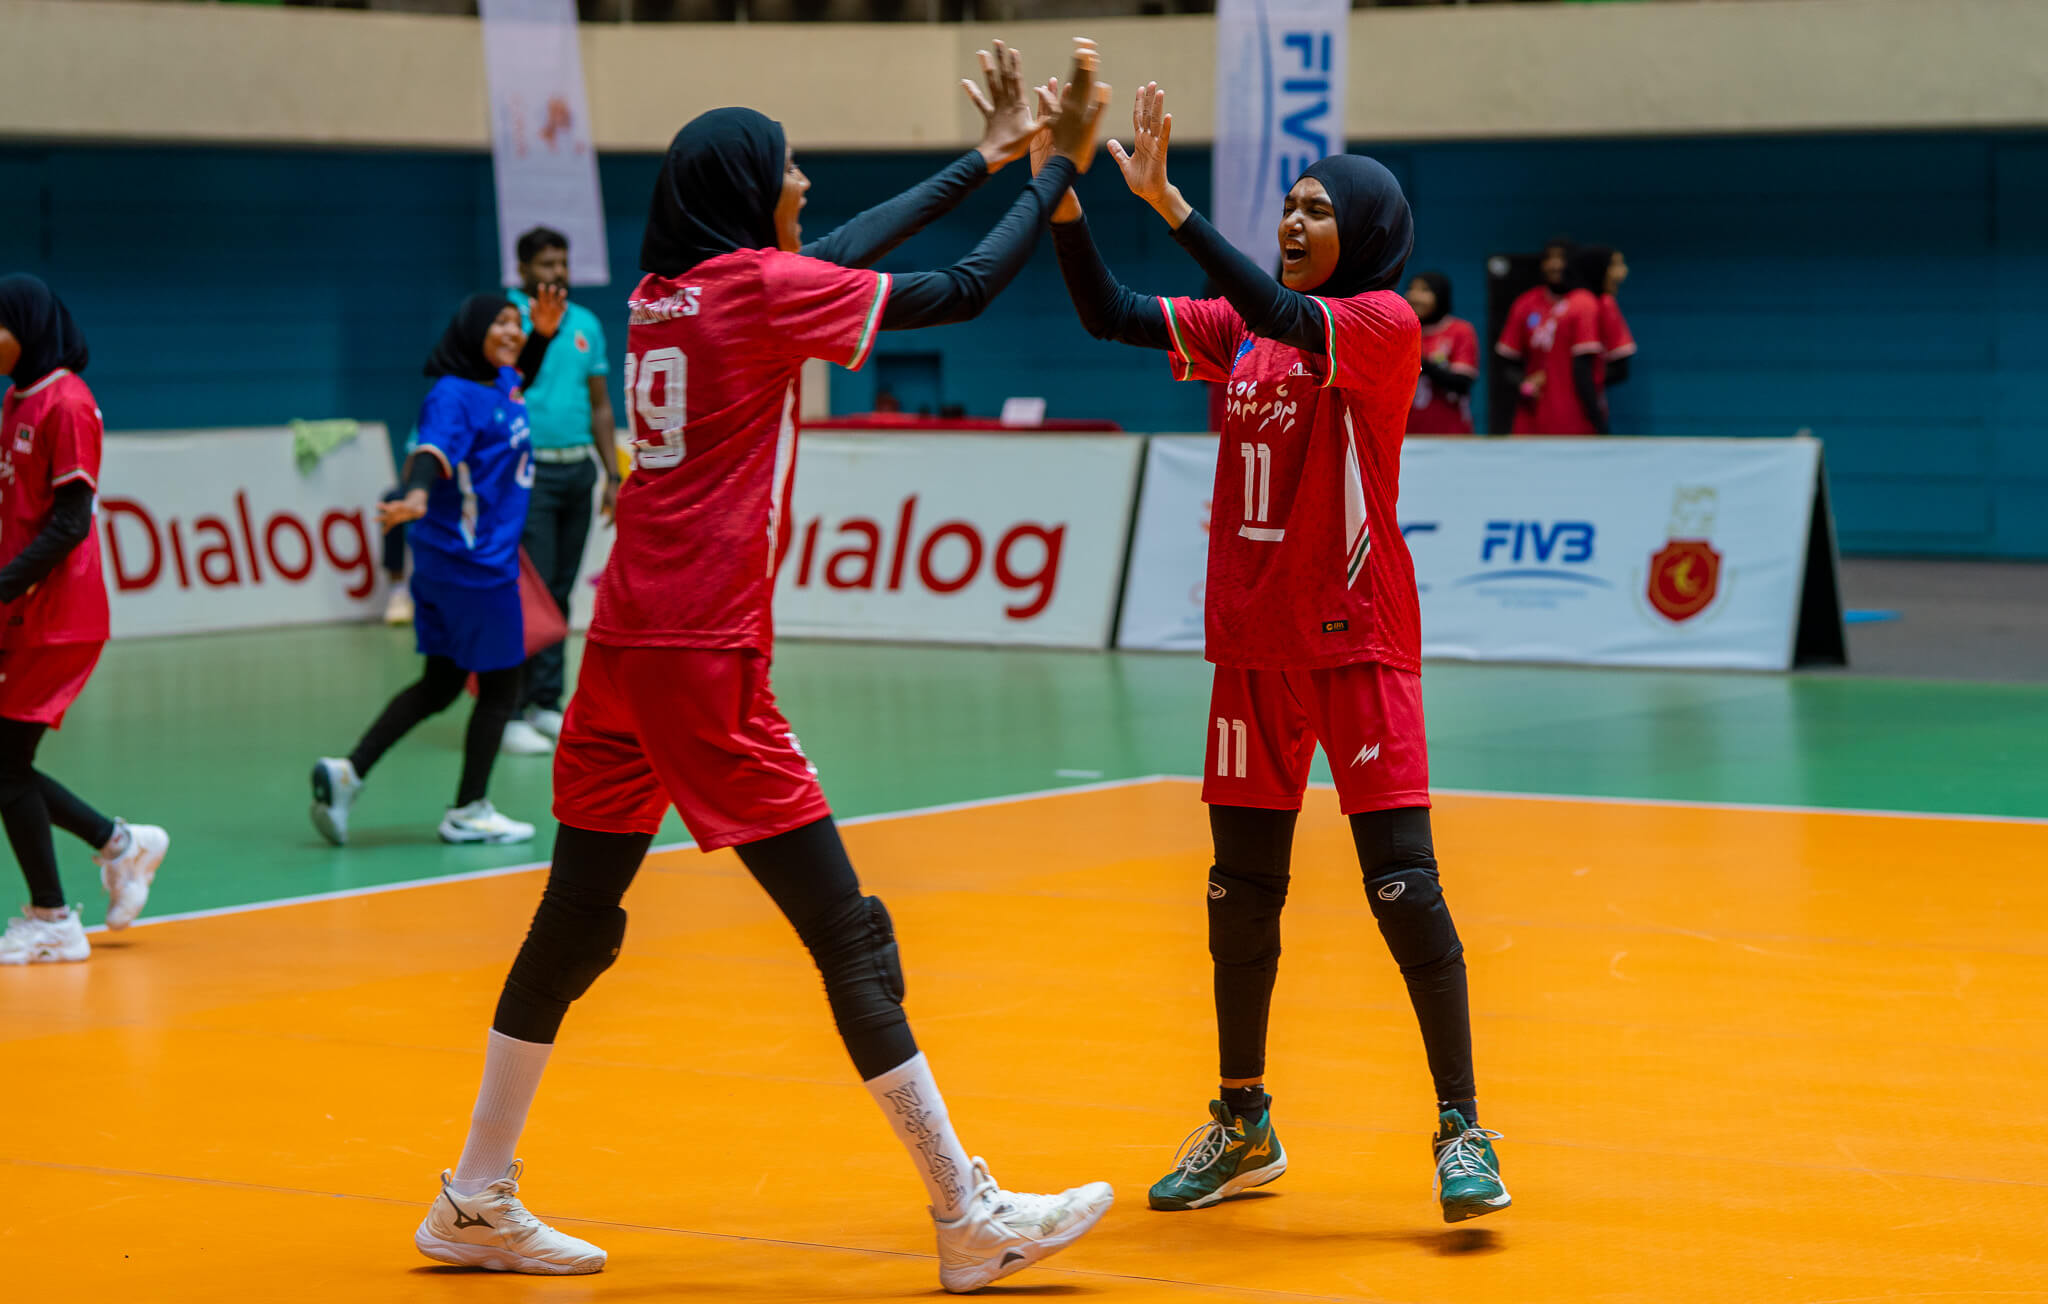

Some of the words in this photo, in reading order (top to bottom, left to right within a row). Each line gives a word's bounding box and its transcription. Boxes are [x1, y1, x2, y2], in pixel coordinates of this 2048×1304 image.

[1241, 442, 1271, 523] 11
[101, 490, 374, 599] Dialog
[776, 493, 1068, 622] ialog
[1481, 521, 1597, 563] FIVB
[1217, 717, 1247, 778] 11
